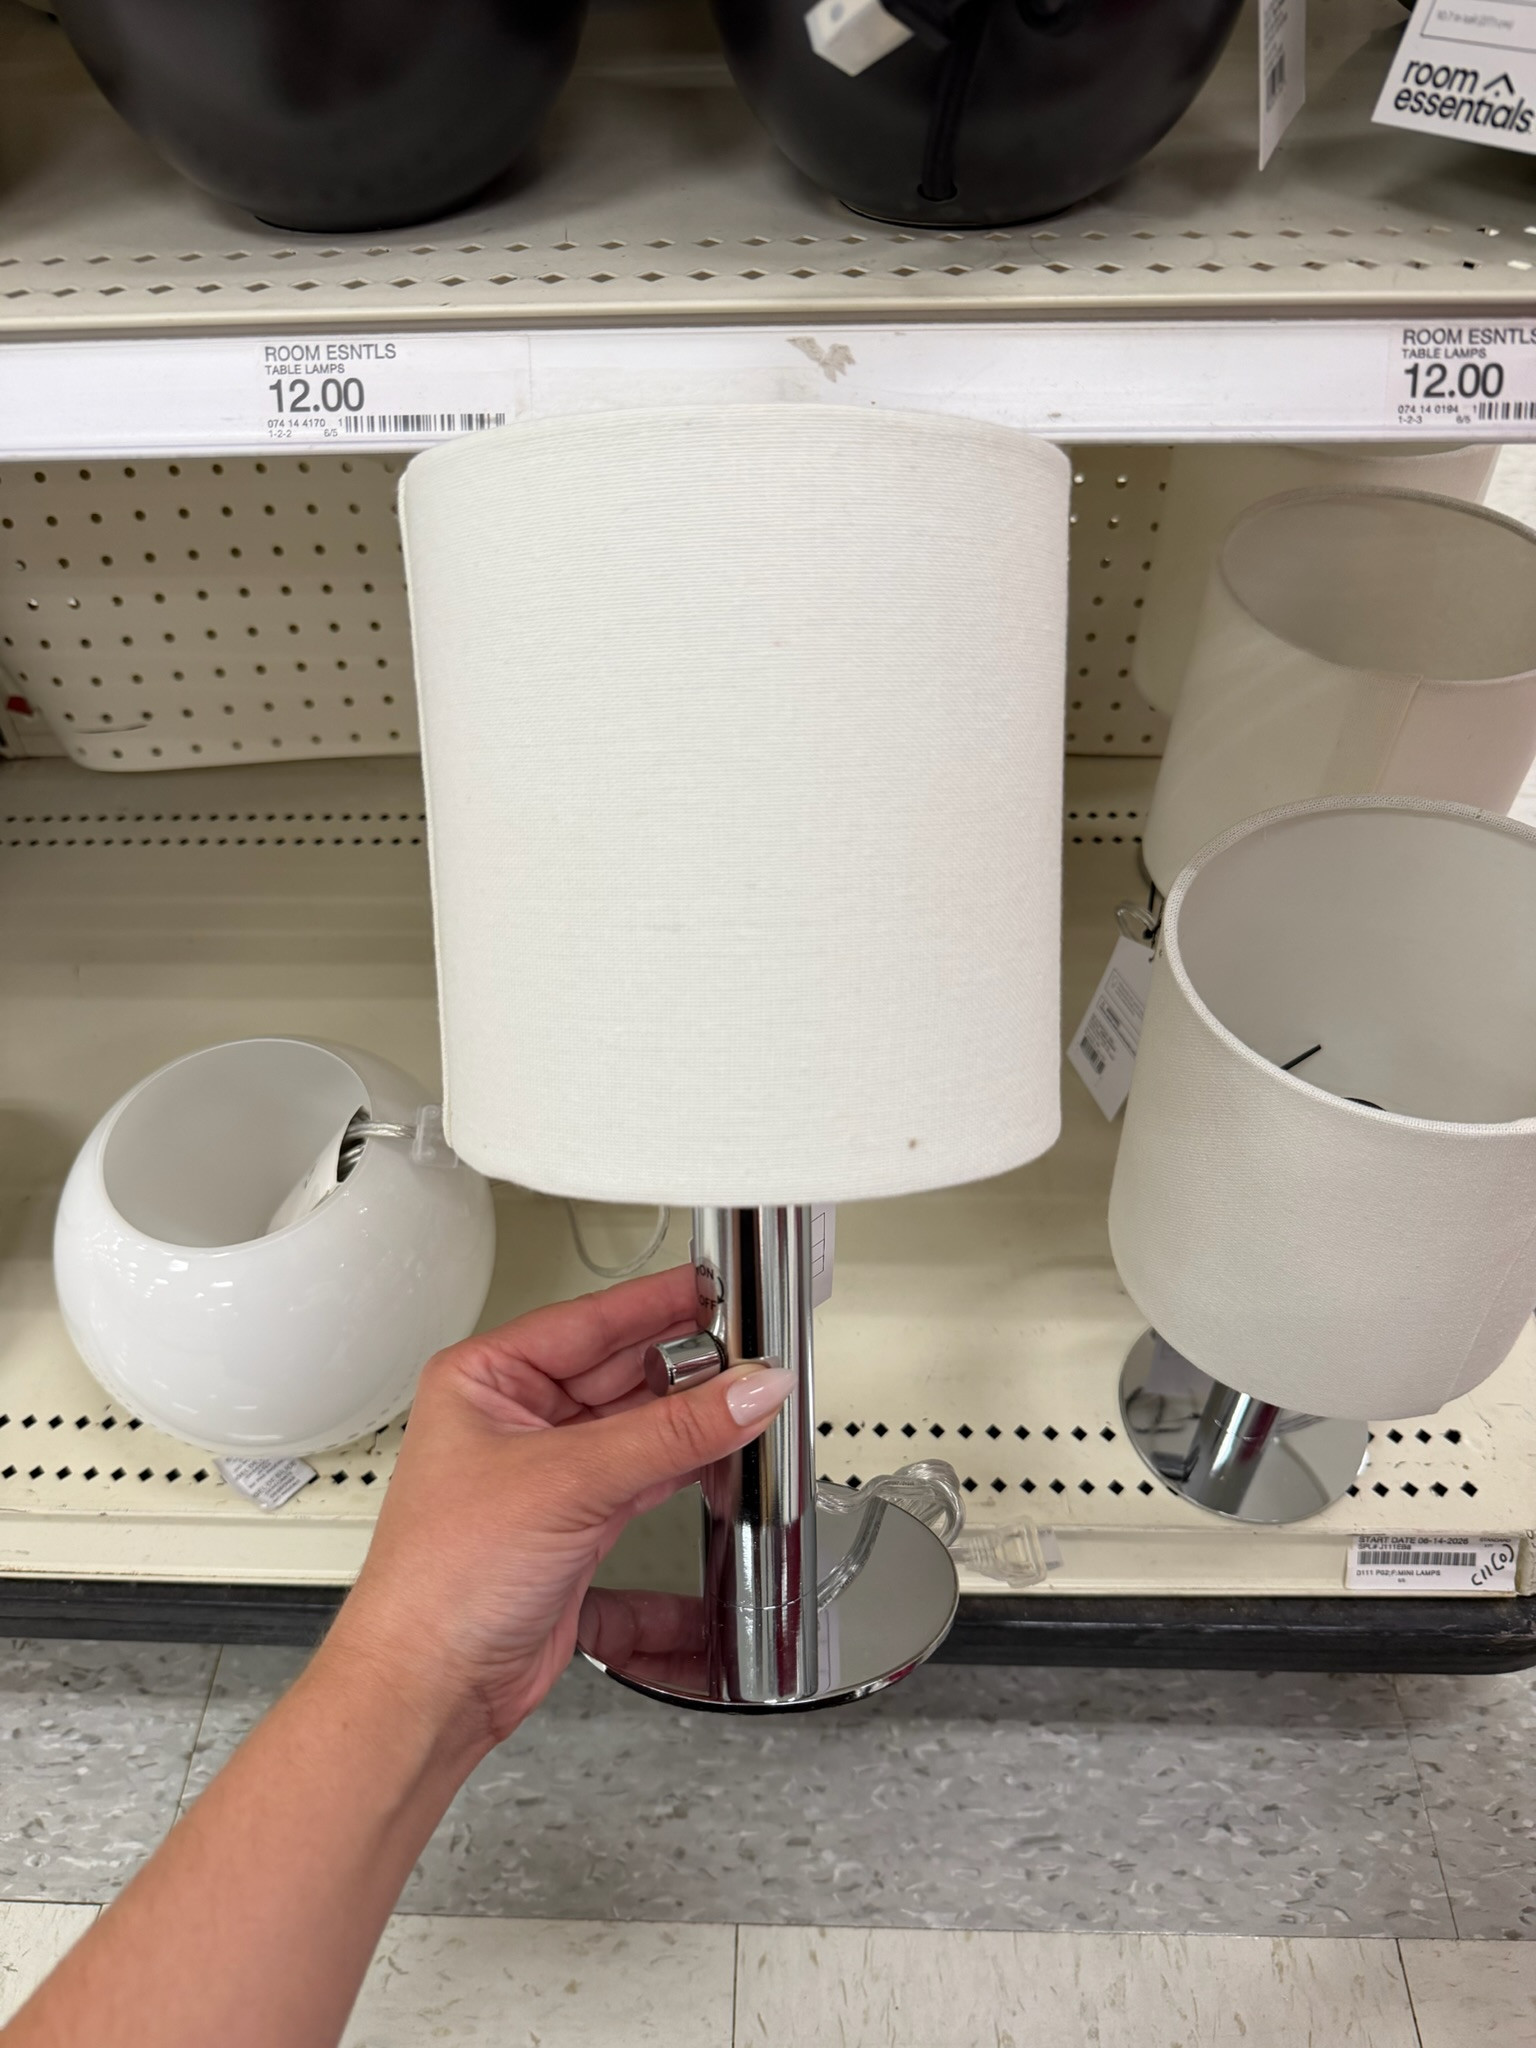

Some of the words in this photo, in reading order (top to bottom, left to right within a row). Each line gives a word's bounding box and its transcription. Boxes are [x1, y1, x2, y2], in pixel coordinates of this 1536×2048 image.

[1402, 60, 1479, 95] room
[1393, 87, 1534, 134] essentials
[1402, 328, 1463, 345] ROOM
[264, 345, 320, 362] ROOM
[326, 343, 397, 361] ESNTLS
[1402, 348, 1441, 359] TABLE
[1444, 348, 1487, 359] LAMPS
[265, 364, 302, 375] TABLE
[305, 363, 345, 375] LAMPS
[1404, 362, 1504, 398] 12.00
[269, 377, 365, 413] 12.00
[1398, 404, 1416, 414] 074
[1420, 404, 1431, 413] 14
[1434, 404, 1459, 413] 0194
[267, 419, 285, 429] 074
[288, 418, 300, 428] 14
[302, 418, 326, 428] 4170
[1398, 416, 1423, 424] 1-2-3
[268, 429, 292, 438] 1-2-2
[1358, 1536, 1389, 1544] START
